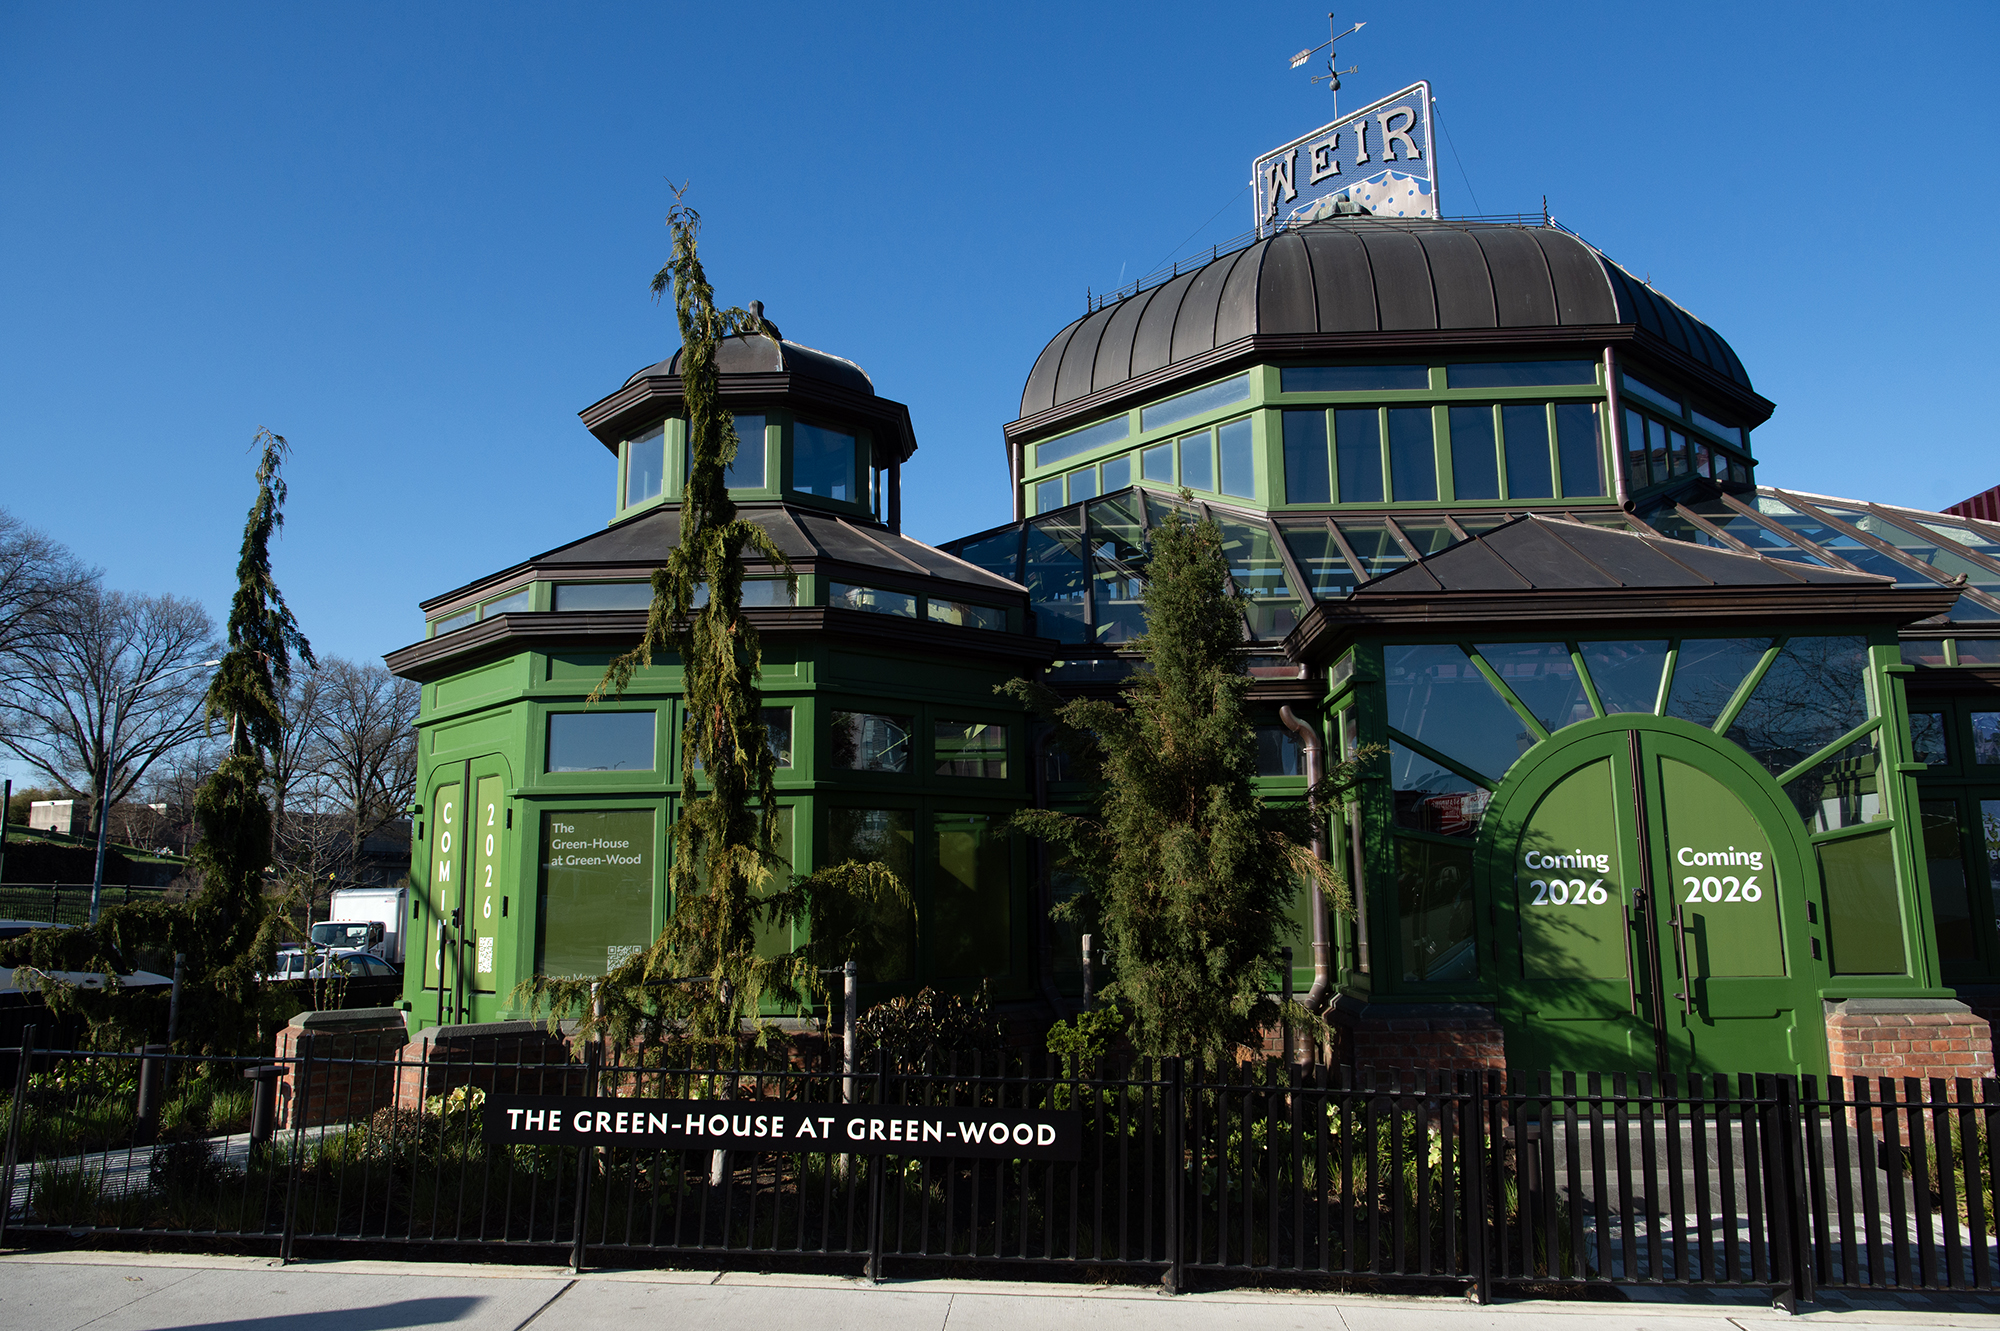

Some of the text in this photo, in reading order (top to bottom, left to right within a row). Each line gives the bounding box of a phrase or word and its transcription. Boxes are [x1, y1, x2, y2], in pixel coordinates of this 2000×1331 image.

[1264, 106, 1421, 223] WEIR
[552, 822, 575, 834] The
[551, 838, 630, 850] Green-House
[483, 803, 495, 919] 2026
[551, 854, 642, 866] at Green-Wood
[1524, 849, 1610, 874] Coming
[1677, 846, 1764, 871] Coming
[1529, 879, 1608, 905] 2026
[1682, 876, 1762, 903] 2026
[506, 1108, 1057, 1147] THE GREEN-HOUSE AT GREEN-WOOD
